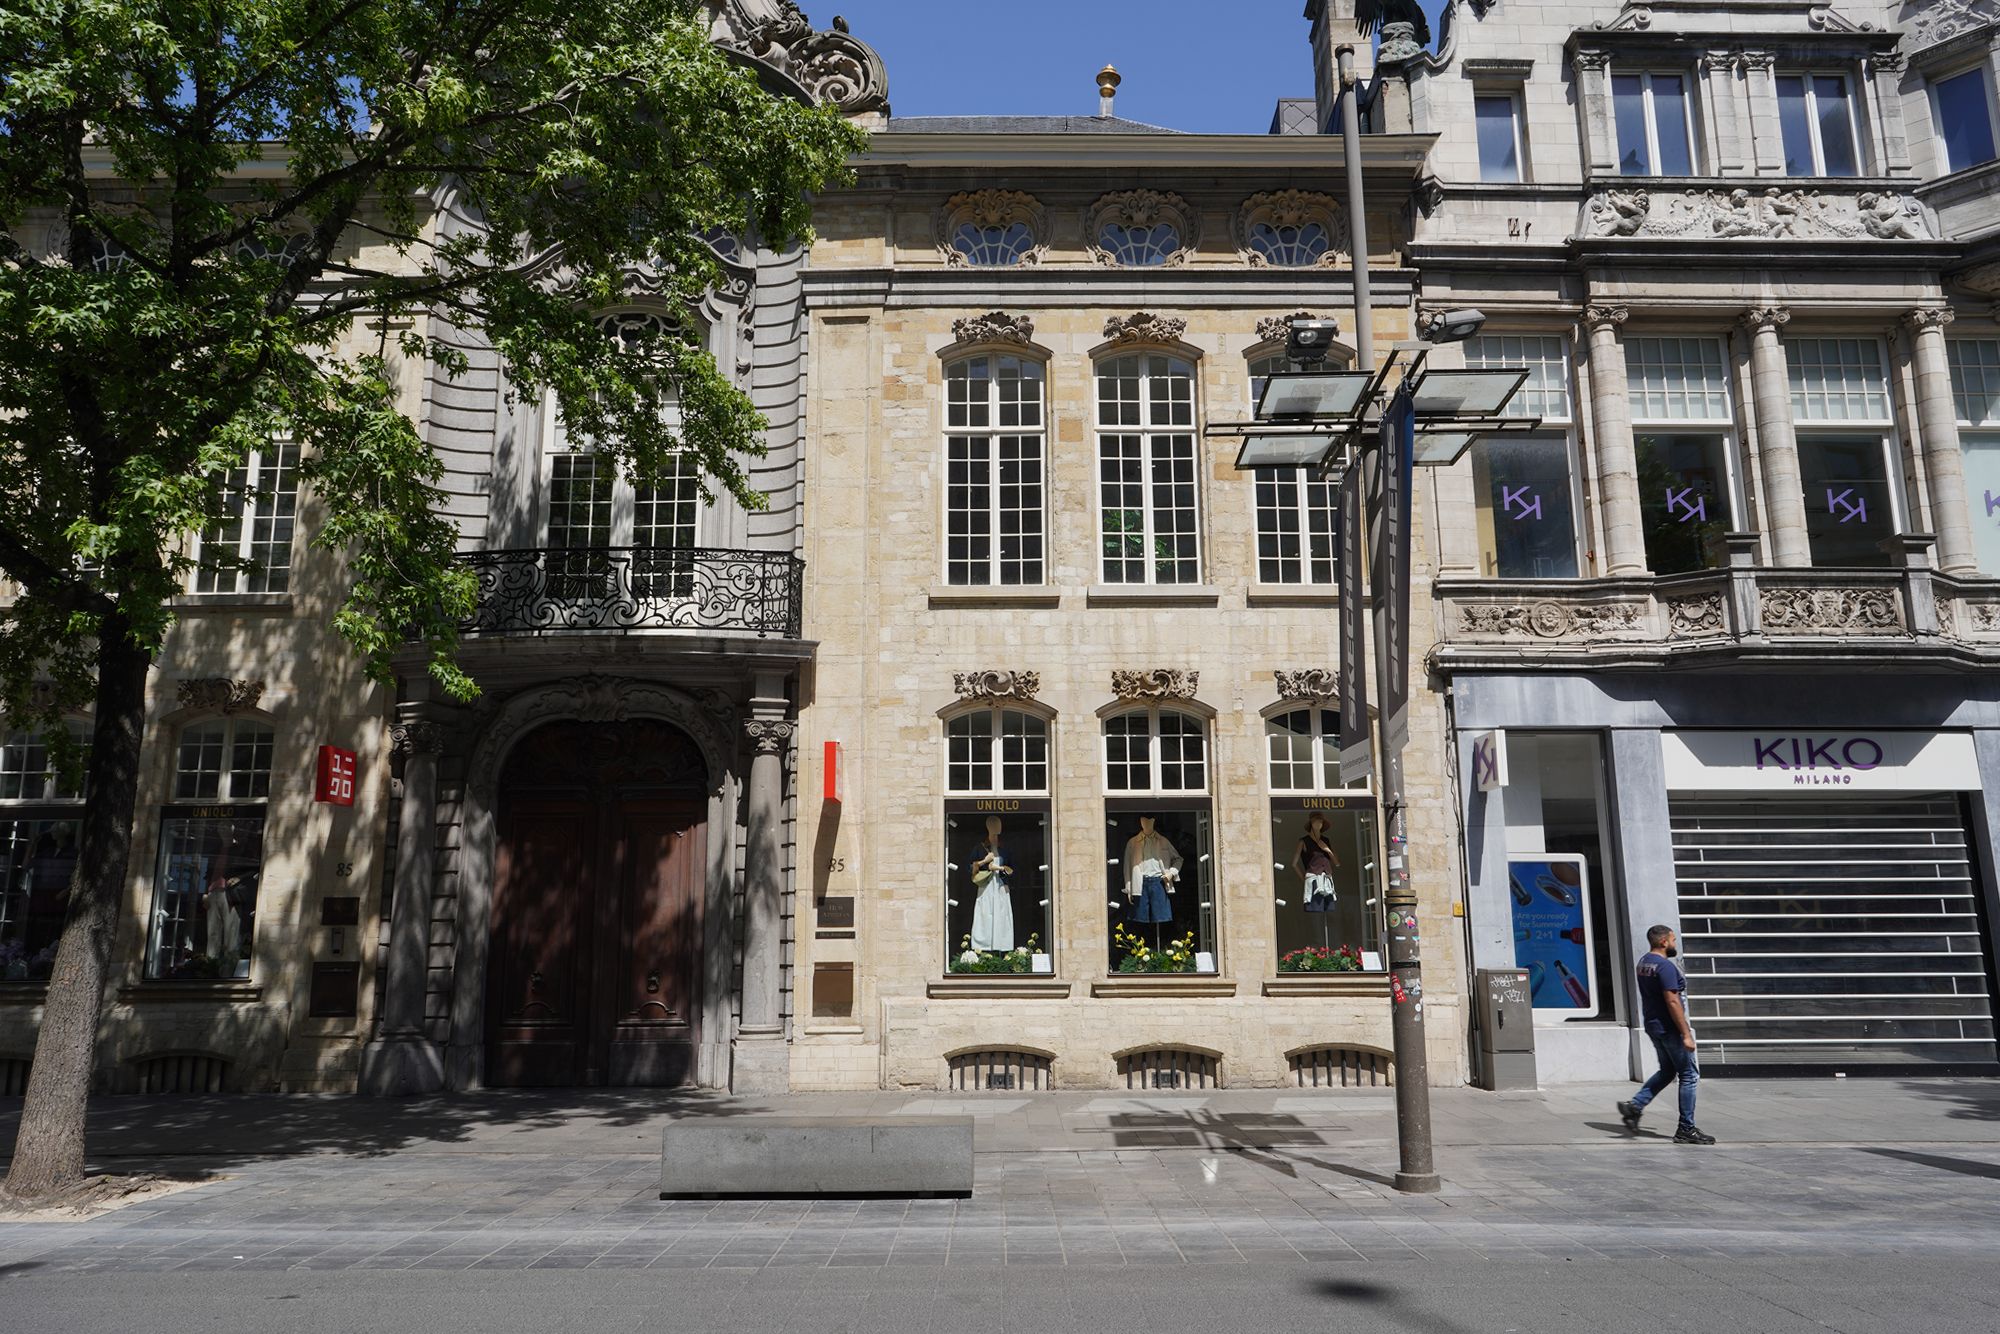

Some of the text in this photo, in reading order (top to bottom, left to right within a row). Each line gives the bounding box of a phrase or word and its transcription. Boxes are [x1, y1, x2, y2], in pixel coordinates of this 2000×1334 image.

[1386, 423, 1400, 696] SKECHERS
[1345, 489, 1358, 732] SKECHERS
[1753, 737, 1883, 771] KIKO
[1793, 774, 1851, 785] MILANO
[976, 799, 1020, 811] UNIQLO
[1302, 797, 1346, 810] UNIQLO
[192, 806, 234, 818] UNIQLO
[336, 862, 353, 878] 85
[828, 858, 845, 873] 85
[1547, 913, 1568, 921] ready
